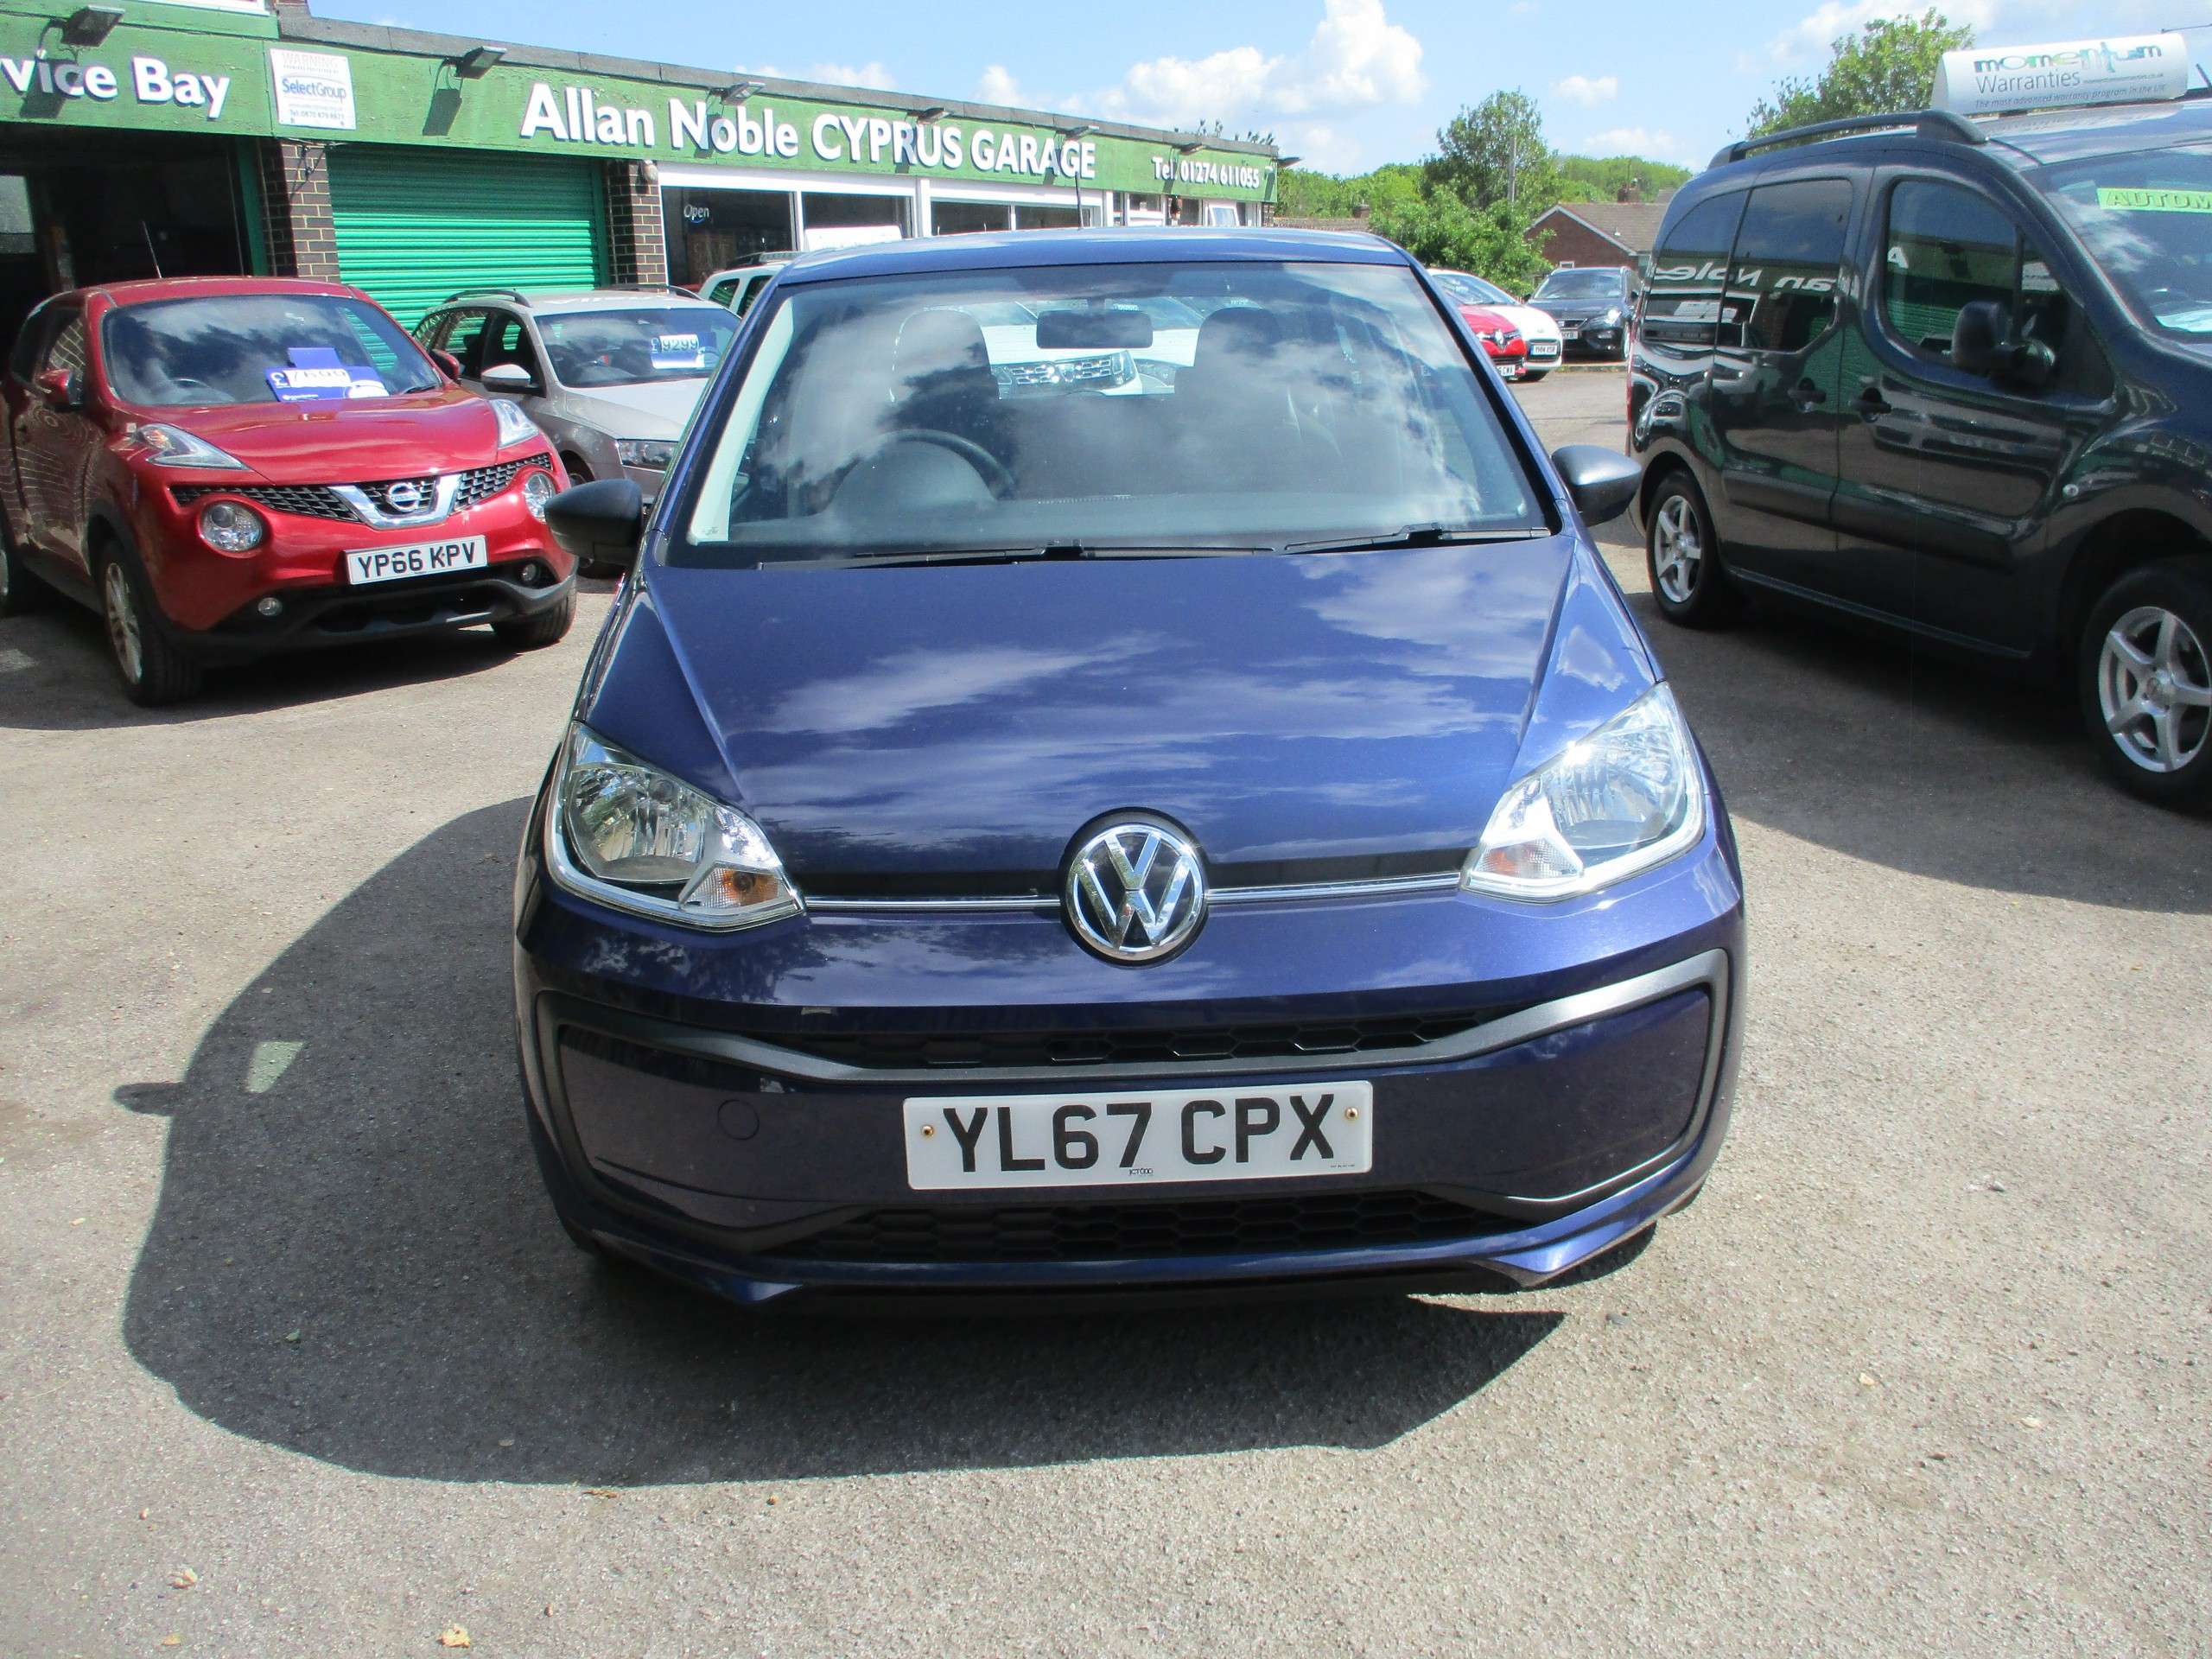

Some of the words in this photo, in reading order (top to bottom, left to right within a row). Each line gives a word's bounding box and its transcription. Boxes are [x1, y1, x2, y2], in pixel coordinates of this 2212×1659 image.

[0, 48, 118, 99] vice
[132, 56, 230, 119] Bay
[282, 78, 346, 104] SelectGroup
[1975, 68, 2081, 94] Warranties
[520, 82, 655, 147] Allan
[669, 97, 799, 157] Noble
[811, 113, 963, 168] CYPRUS
[970, 130, 1096, 180] GARAGE
[1180, 159, 1217, 184] 01274
[1219, 163, 1259, 188] 611055
[683, 204, 709, 221] Open
[357, 550, 423, 578] YP66
[429, 542, 475, 569] KPV
[943, 1103, 1153, 1173] YL67
[1180, 1093, 1335, 1166] CPX
